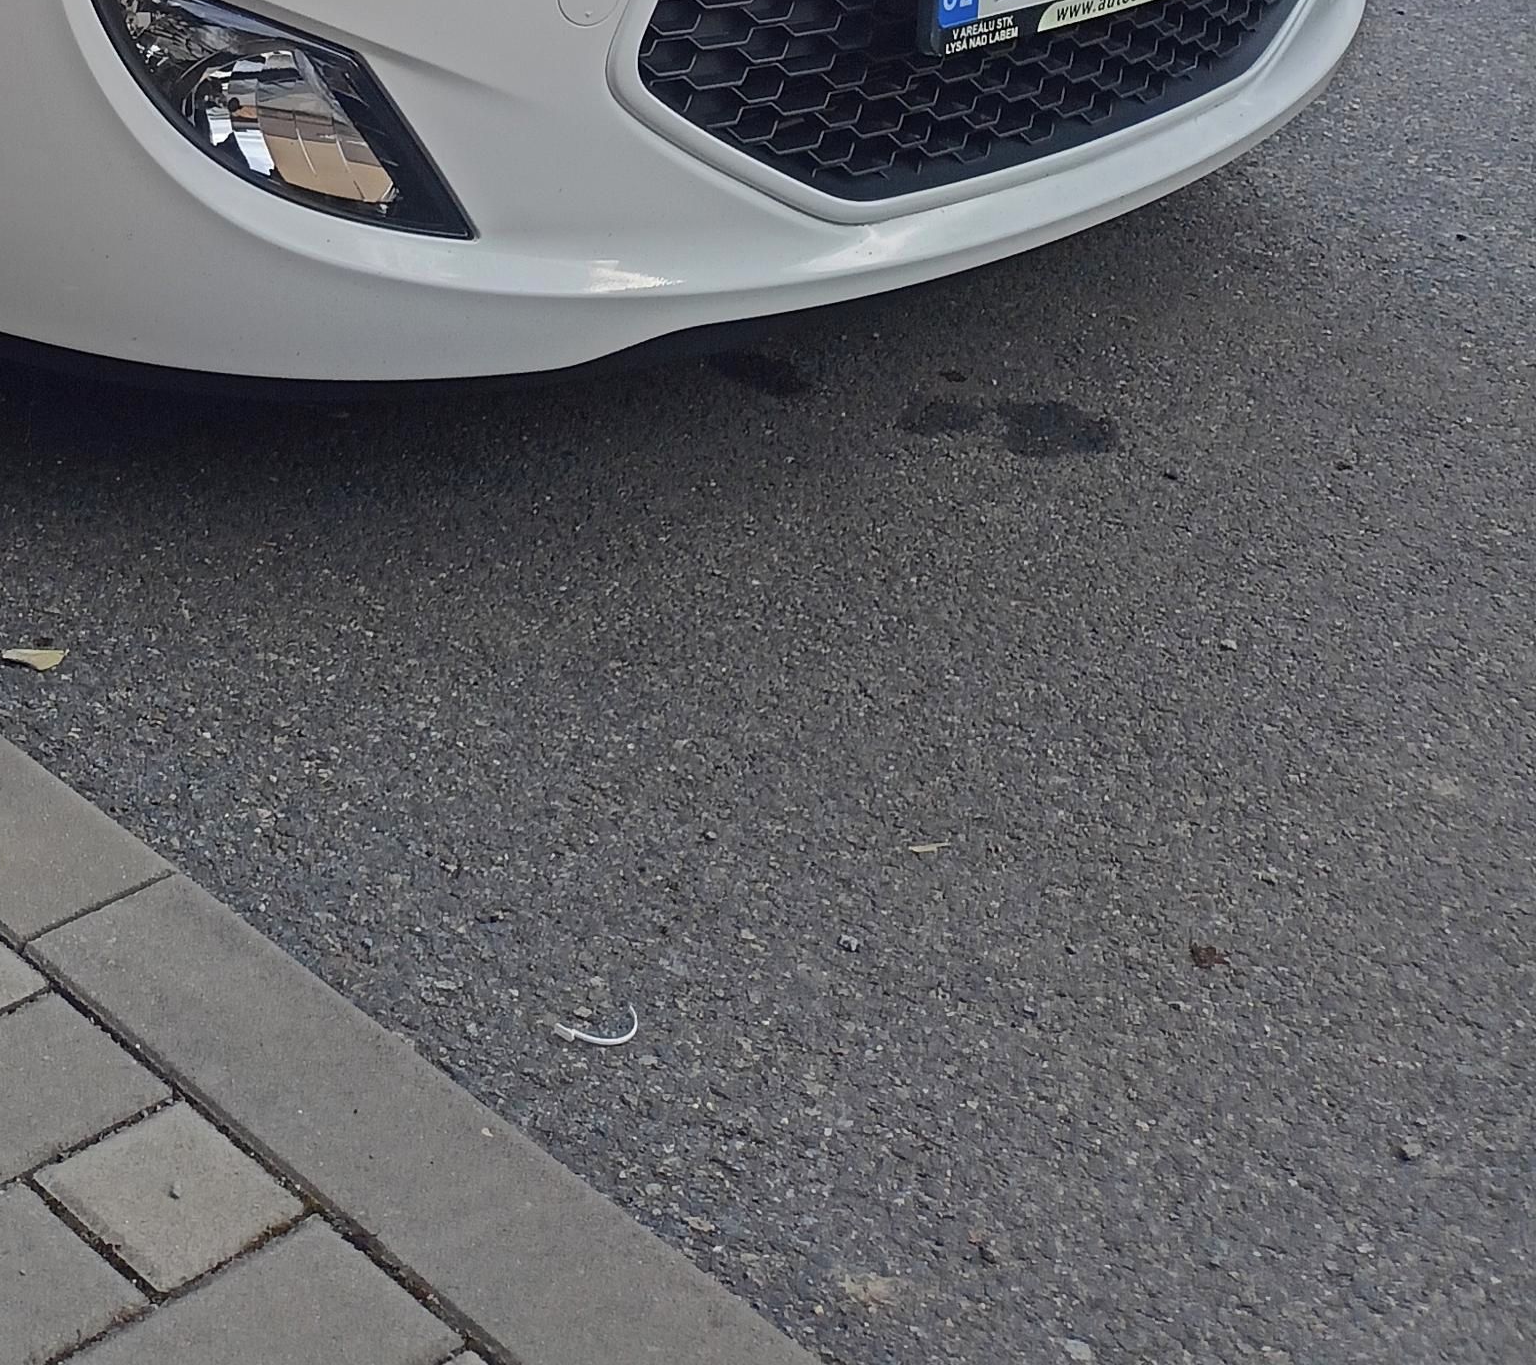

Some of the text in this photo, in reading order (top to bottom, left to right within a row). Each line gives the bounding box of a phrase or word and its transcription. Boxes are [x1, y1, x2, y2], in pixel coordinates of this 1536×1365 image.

[996, 15, 1013, 29] STK
[969, 34, 987, 49] NAD
[989, 26, 1018, 44] LABEM
